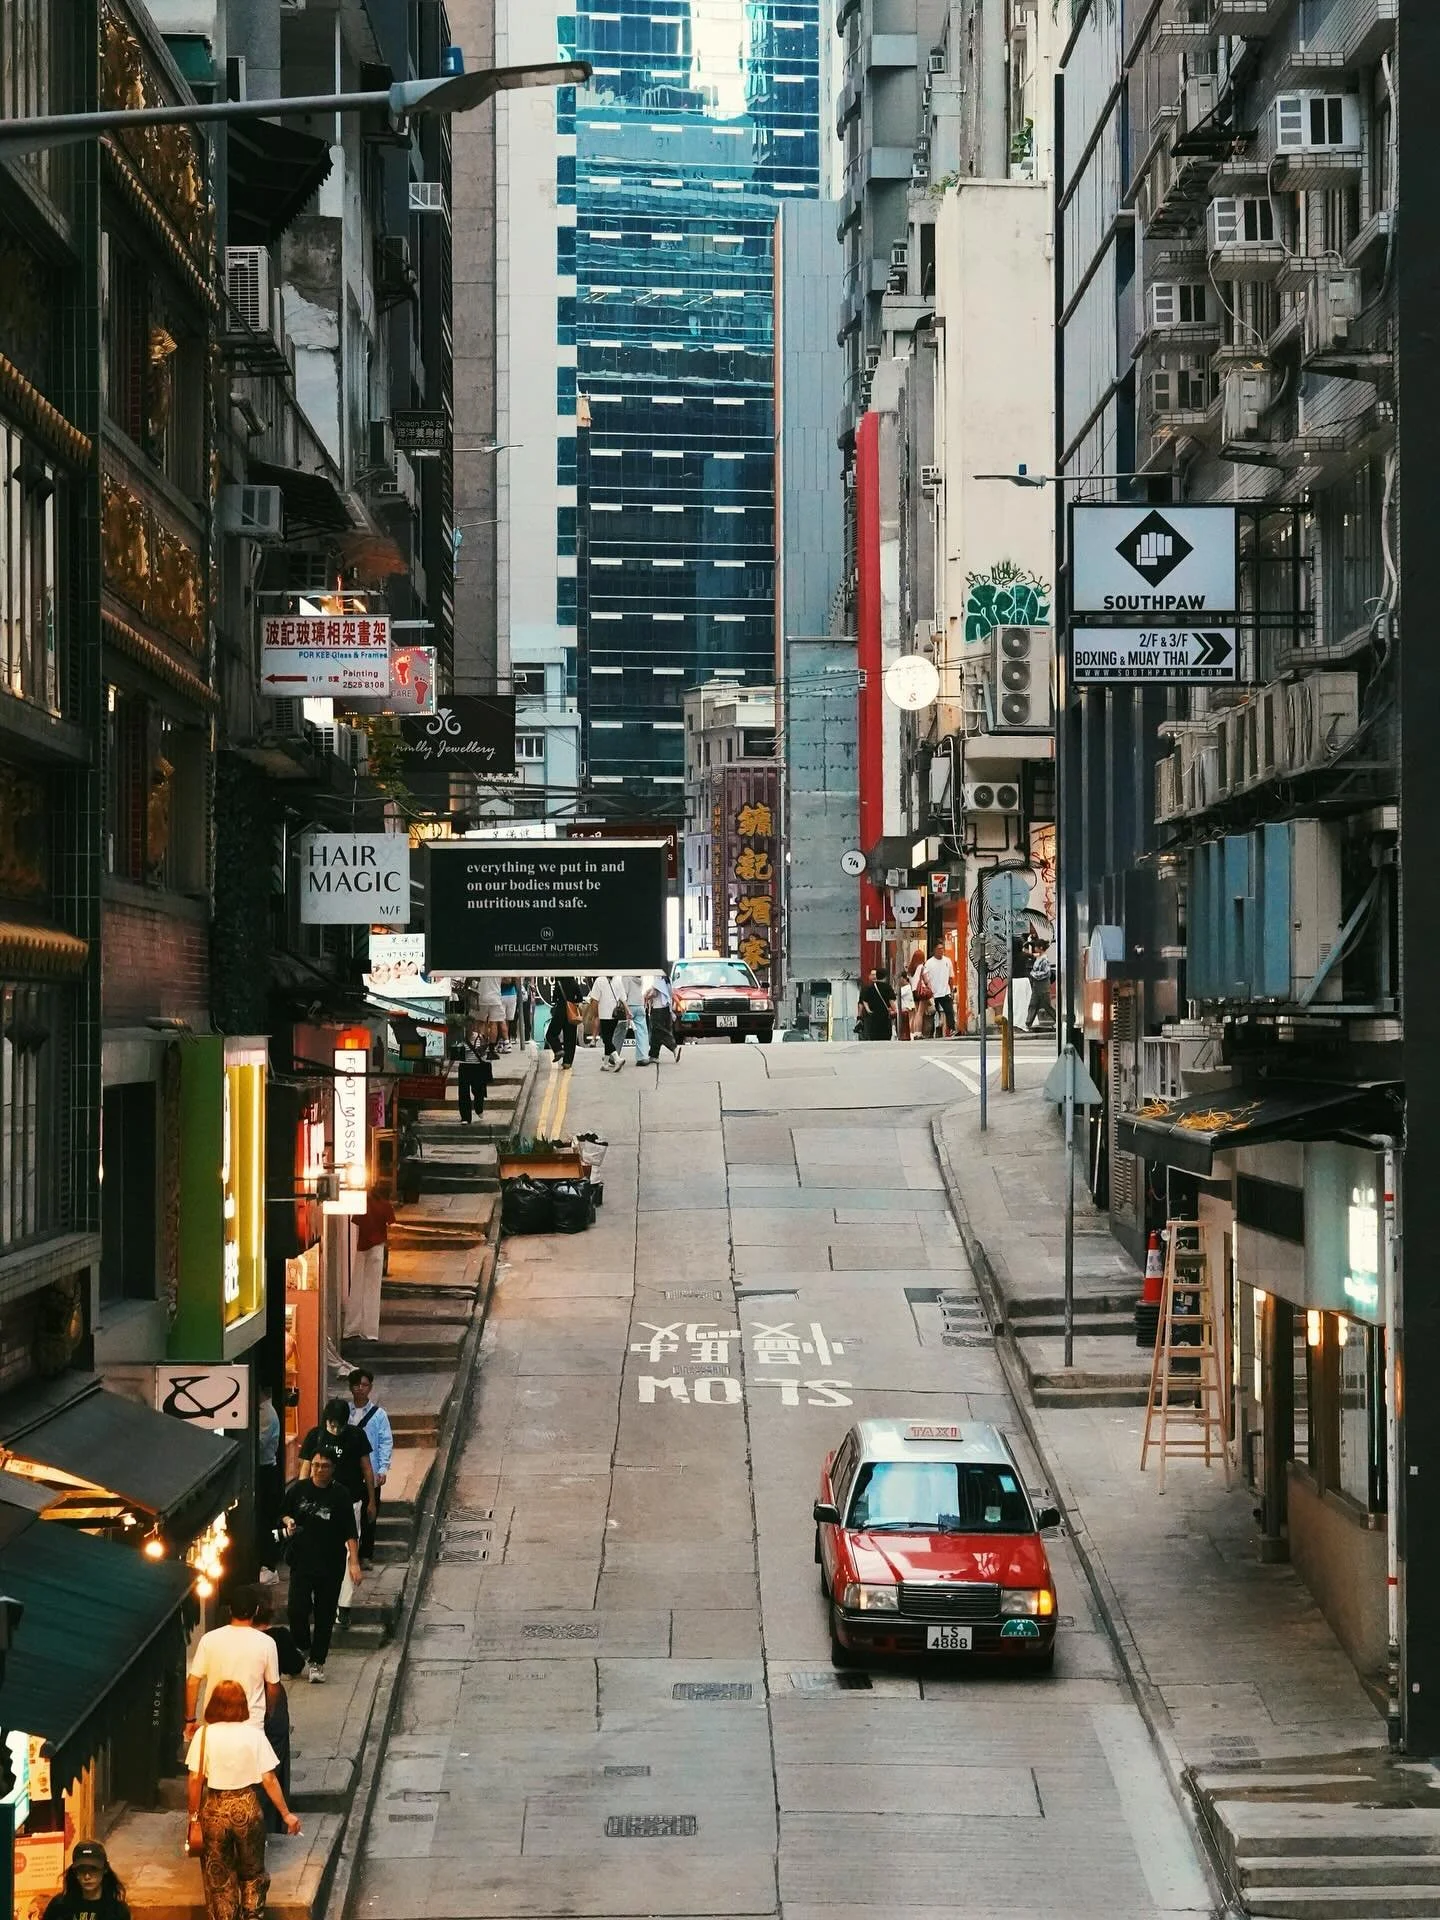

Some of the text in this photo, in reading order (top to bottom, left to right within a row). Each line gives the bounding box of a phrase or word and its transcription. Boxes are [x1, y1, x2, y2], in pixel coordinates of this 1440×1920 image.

[1103, 595, 1206, 610] SOUTHPAW
[265, 620, 386, 646] 波記玻璃相架畫架
[1139, 633, 1188, 648] 2/F & 3/F
[331, 651, 353, 659] Glass
[353, 651, 360, 659] &
[360, 651, 388, 659] Frames
[1075, 651, 1189, 666] BOXING & MUAY THAI
[311, 675, 324, 683] 1/F
[342, 669, 379, 679] Painting
[364, 681, 385, 689] 8108
[391, 689, 412, 698] CARE
[437, 740, 496, 760] Jewellery
[309, 845, 377, 867] HAIR
[466, 860, 625, 876] everything we put in and
[309, 871, 401, 893] MAGIC
[467, 879, 601, 891] on our bodies must be
[467, 896, 588, 909] nutritious and safe.
[379, 905, 401, 916] M/F
[543, 930, 552, 938] IN
[494, 943, 599, 952] INTELLIGENT NUTRIENTS
[344, 1057, 356, 1096] FOOT
[344, 1106, 356, 1164] MASSA
[638, 1375, 853, 1407] SLOW
[911, 1426, 958, 1438] TAXI
[940, 1626, 959, 1637] LS
[1016, 1623, 1025, 1631] 4
[931, 1637, 968, 1649] 4888
